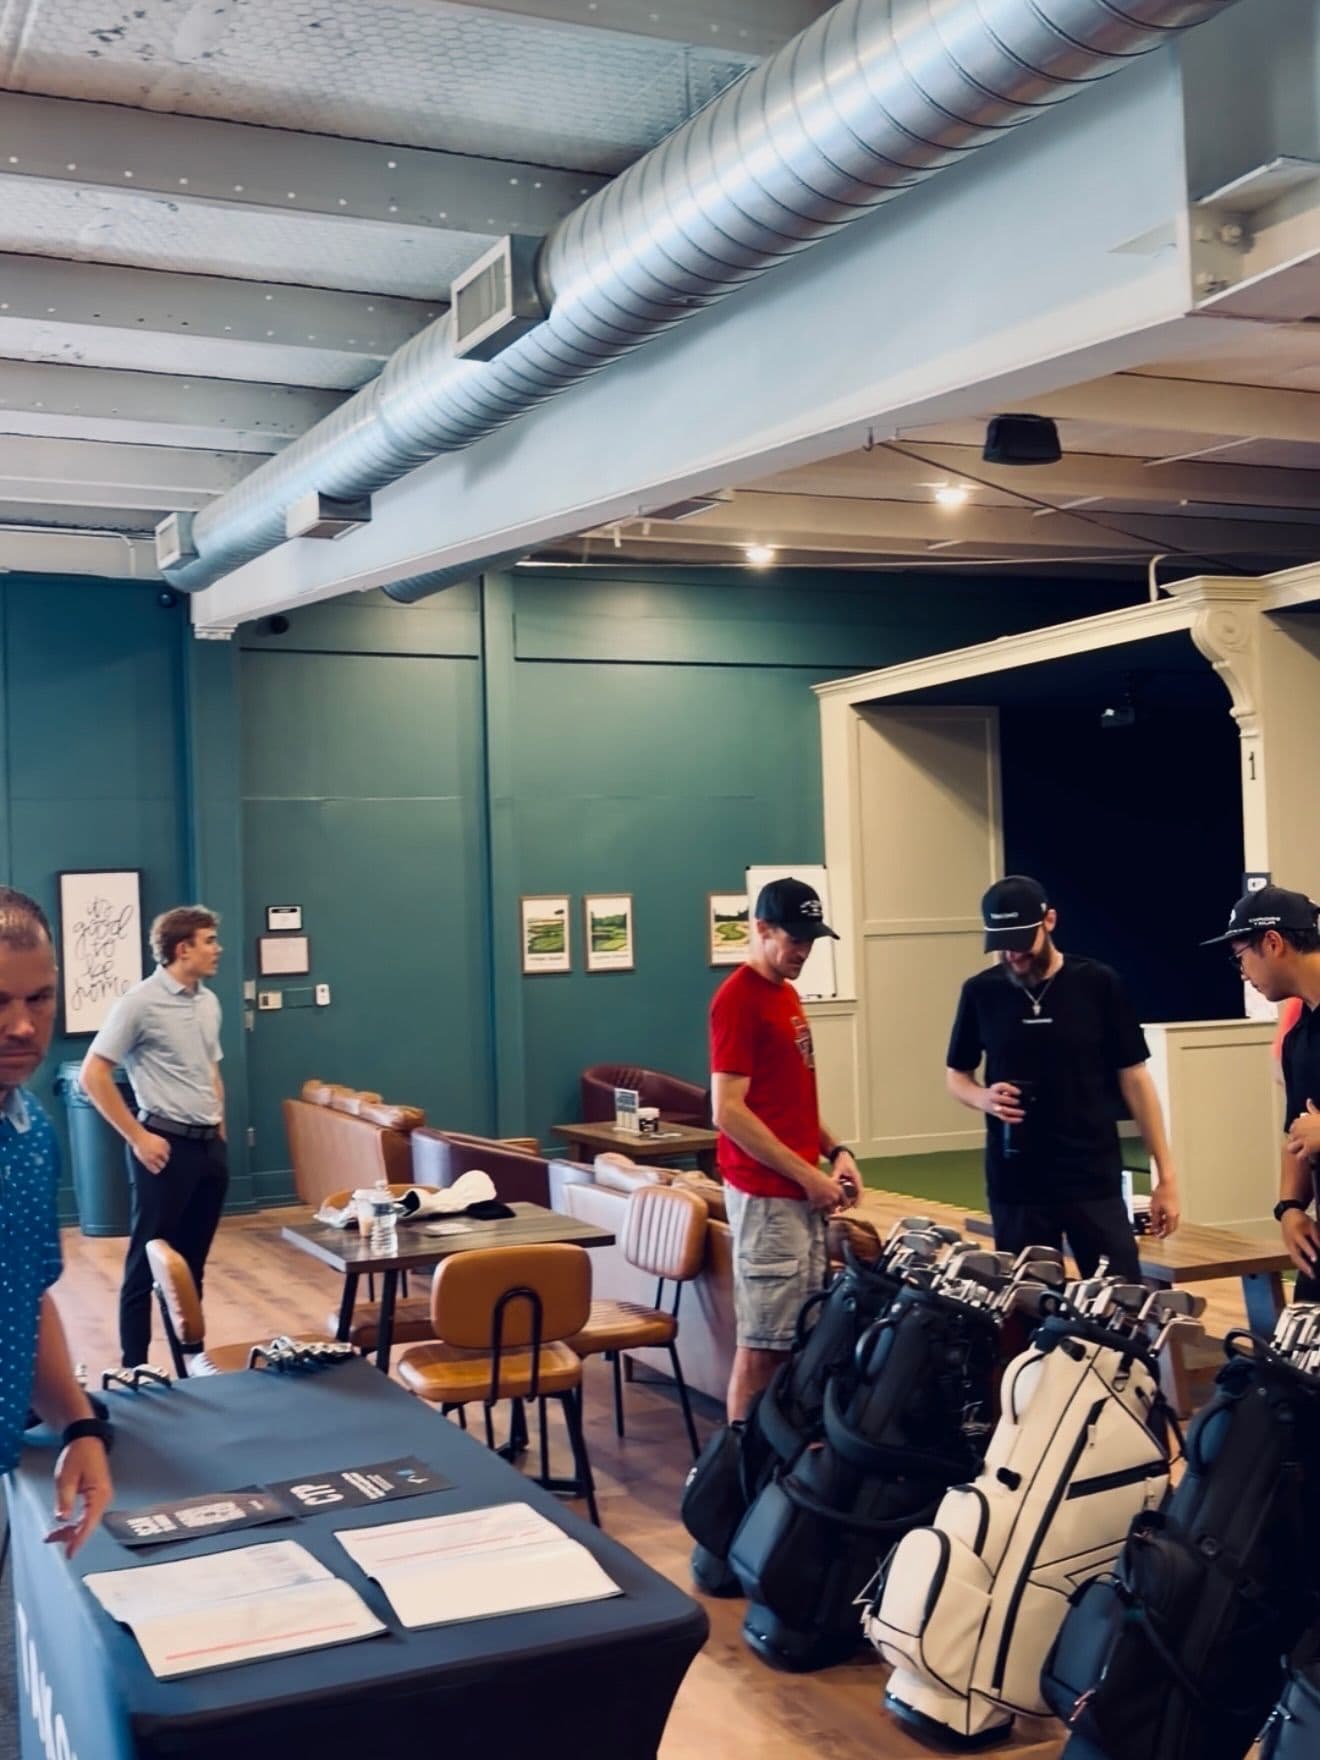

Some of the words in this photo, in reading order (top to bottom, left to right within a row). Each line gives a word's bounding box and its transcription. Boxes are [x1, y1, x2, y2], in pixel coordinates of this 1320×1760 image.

[1249, 751, 1257, 781] 1
[71, 904, 134, 962] good
[90, 938, 116, 958] to
[82, 955, 113, 981] be
